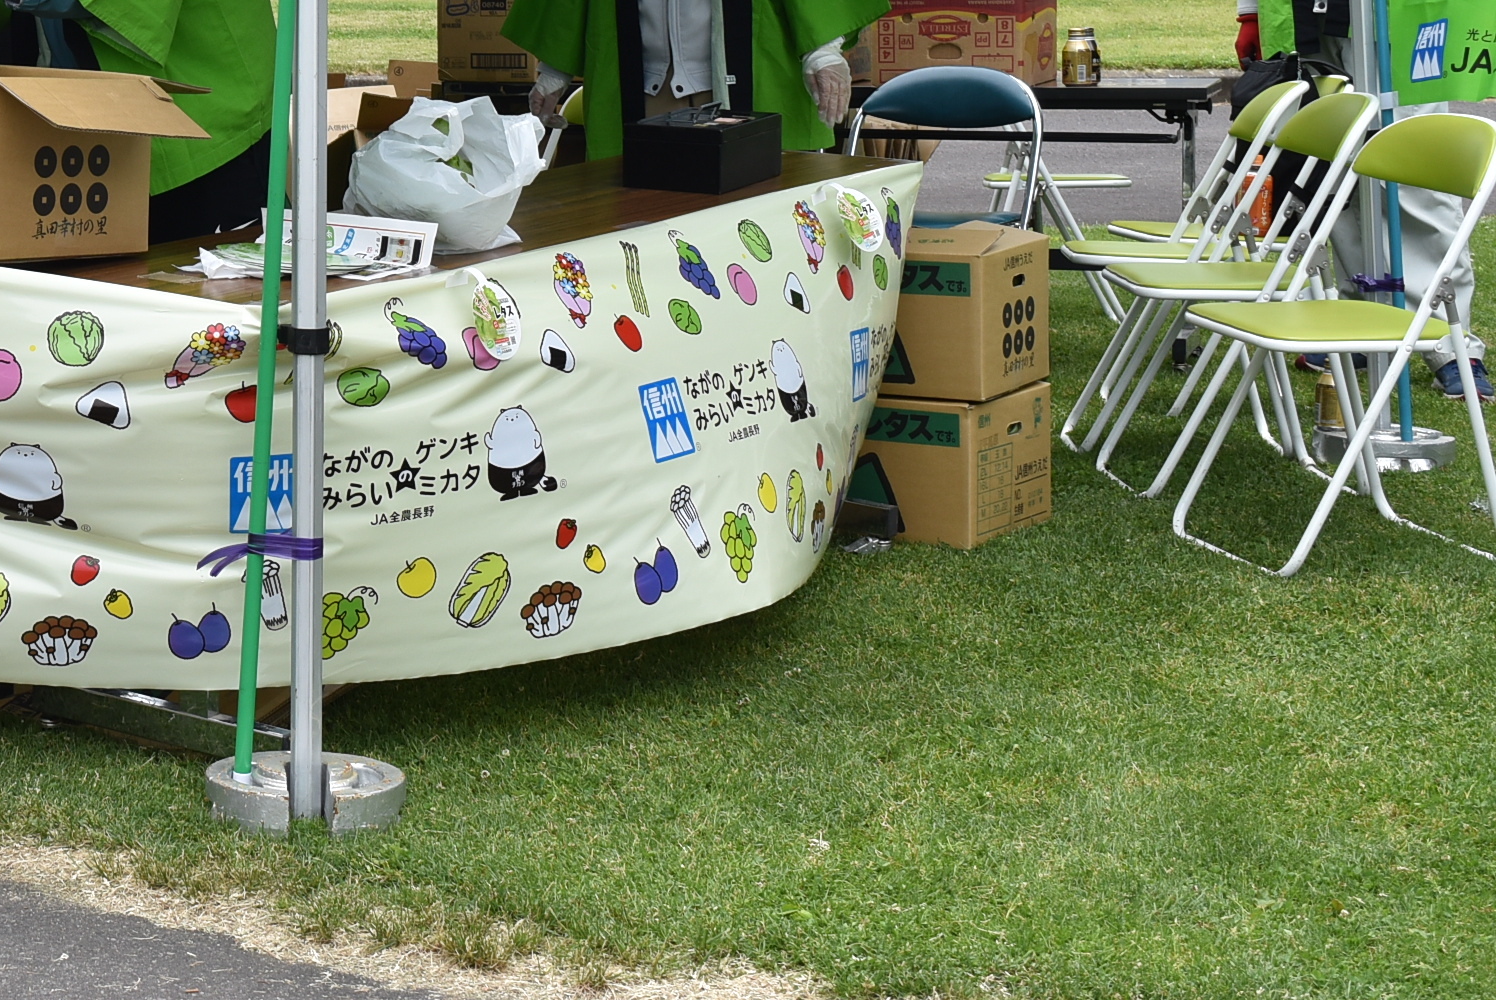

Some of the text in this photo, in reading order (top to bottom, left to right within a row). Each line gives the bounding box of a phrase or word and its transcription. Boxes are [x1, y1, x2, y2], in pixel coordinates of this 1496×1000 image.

[1415, 23, 1445, 50] 信州
[1466, 28, 1496, 43] 光と
[1450, 47, 1496, 74] JA
[856, 203, 874, 217] レタス
[32, 216, 107, 239] 真田幸村の里
[901, 265, 967, 293] タスです。
[493, 305, 514, 319] レタス
[683, 358, 768, 399] ながの ゲンキ
[643, 382, 683, 420] 信州
[693, 401, 735, 431] みらい
[743, 386, 776, 415] ミカタ
[728, 424, 760, 443] JA全農長野
[323, 431, 480, 478] ながの ゲンキ
[233, 460, 294, 493] 信州
[322, 480, 394, 511] みらい
[418, 463, 481, 496] ミカタ
[370, 505, 434, 526] JA全農長野
